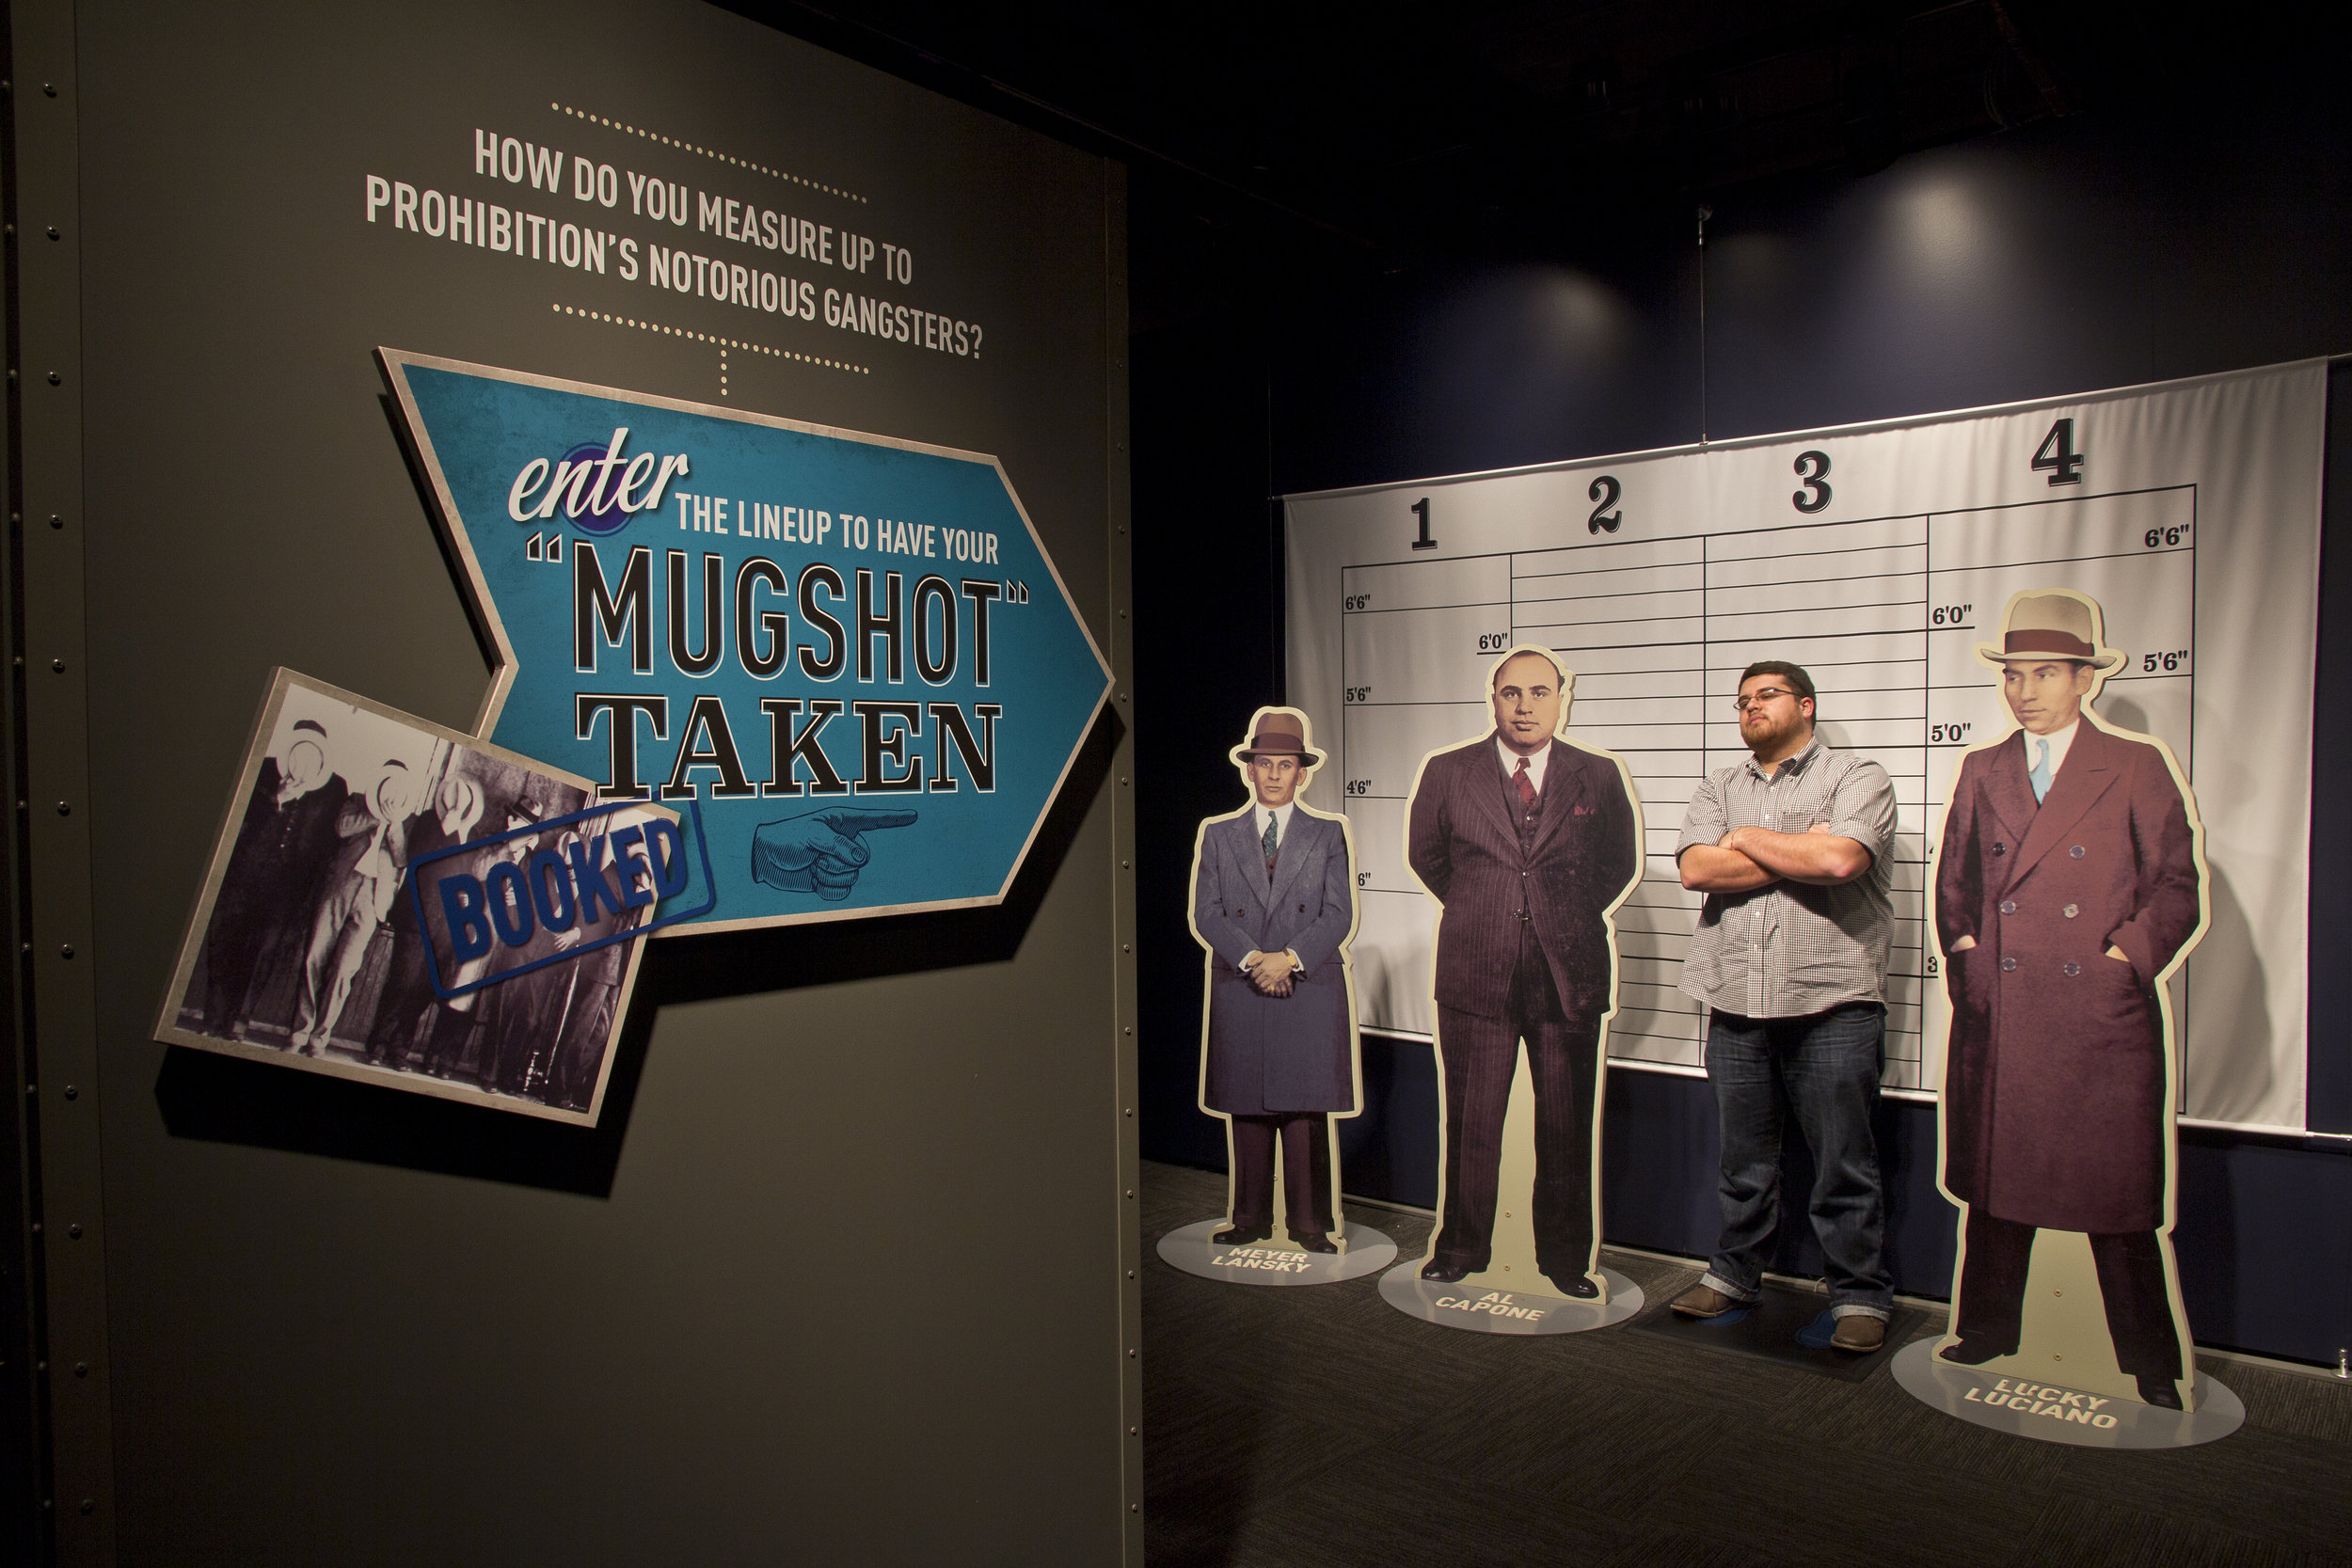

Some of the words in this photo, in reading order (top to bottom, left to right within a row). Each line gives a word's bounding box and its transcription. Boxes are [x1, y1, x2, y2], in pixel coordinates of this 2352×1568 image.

[475, 128, 563, 193] HOW
[574, 155, 618, 208] DO
[627, 170, 688, 226] YOU
[698, 191, 834, 266] MEASURE
[841, 232, 875, 274] UP
[882, 242, 913, 285] TO
[366, 174, 640, 281] PROHIBITION'S
[649, 244, 816, 322] NOTORIOUS
[823, 289, 983, 359] GANGSTERS?
[2030, 417, 2085, 487] 4
[508, 426, 690, 523] enter
[1792, 450, 1833, 514] 3
[1587, 475, 1622, 535] 2
[675, 492, 729, 534] THE
[738, 500, 832, 545] LINEUP
[839, 514, 870, 549] TO
[877, 519, 937, 558] HAVE
[942, 526, 999, 565] YOUR
[1410, 497, 1438, 551] 1
[2144, 524, 2190, 547] 6'6"
[525, 531, 1029, 688] "MUGSHOT"
[1345, 594, 1371, 610] 6'6"
[1931, 604, 1973, 625] 6'0"
[1478, 632, 1508, 650] 6'0"
[2142, 650, 2188, 673] 5'6"
[1345, 686, 1371, 703] 5'6"
[574, 691, 1002, 800] TAKEN
[1931, 722, 1972, 743] 5'0"
[1346, 779, 1372, 795] 4'6"
[437, 816, 689, 964] BOOKED
[1358, 872, 1372, 887] 6"
[1211, 1256, 1312, 1274] LANSKY
[1228, 1247, 1309, 1263] MEYER
[1435, 1296, 1546, 1322] CAPONE
[1479, 1291, 1514, 1306] AL
[1963, 1387, 2119, 1429] LUCIANO
[1994, 1378, 2110, 1411] LUCKY
